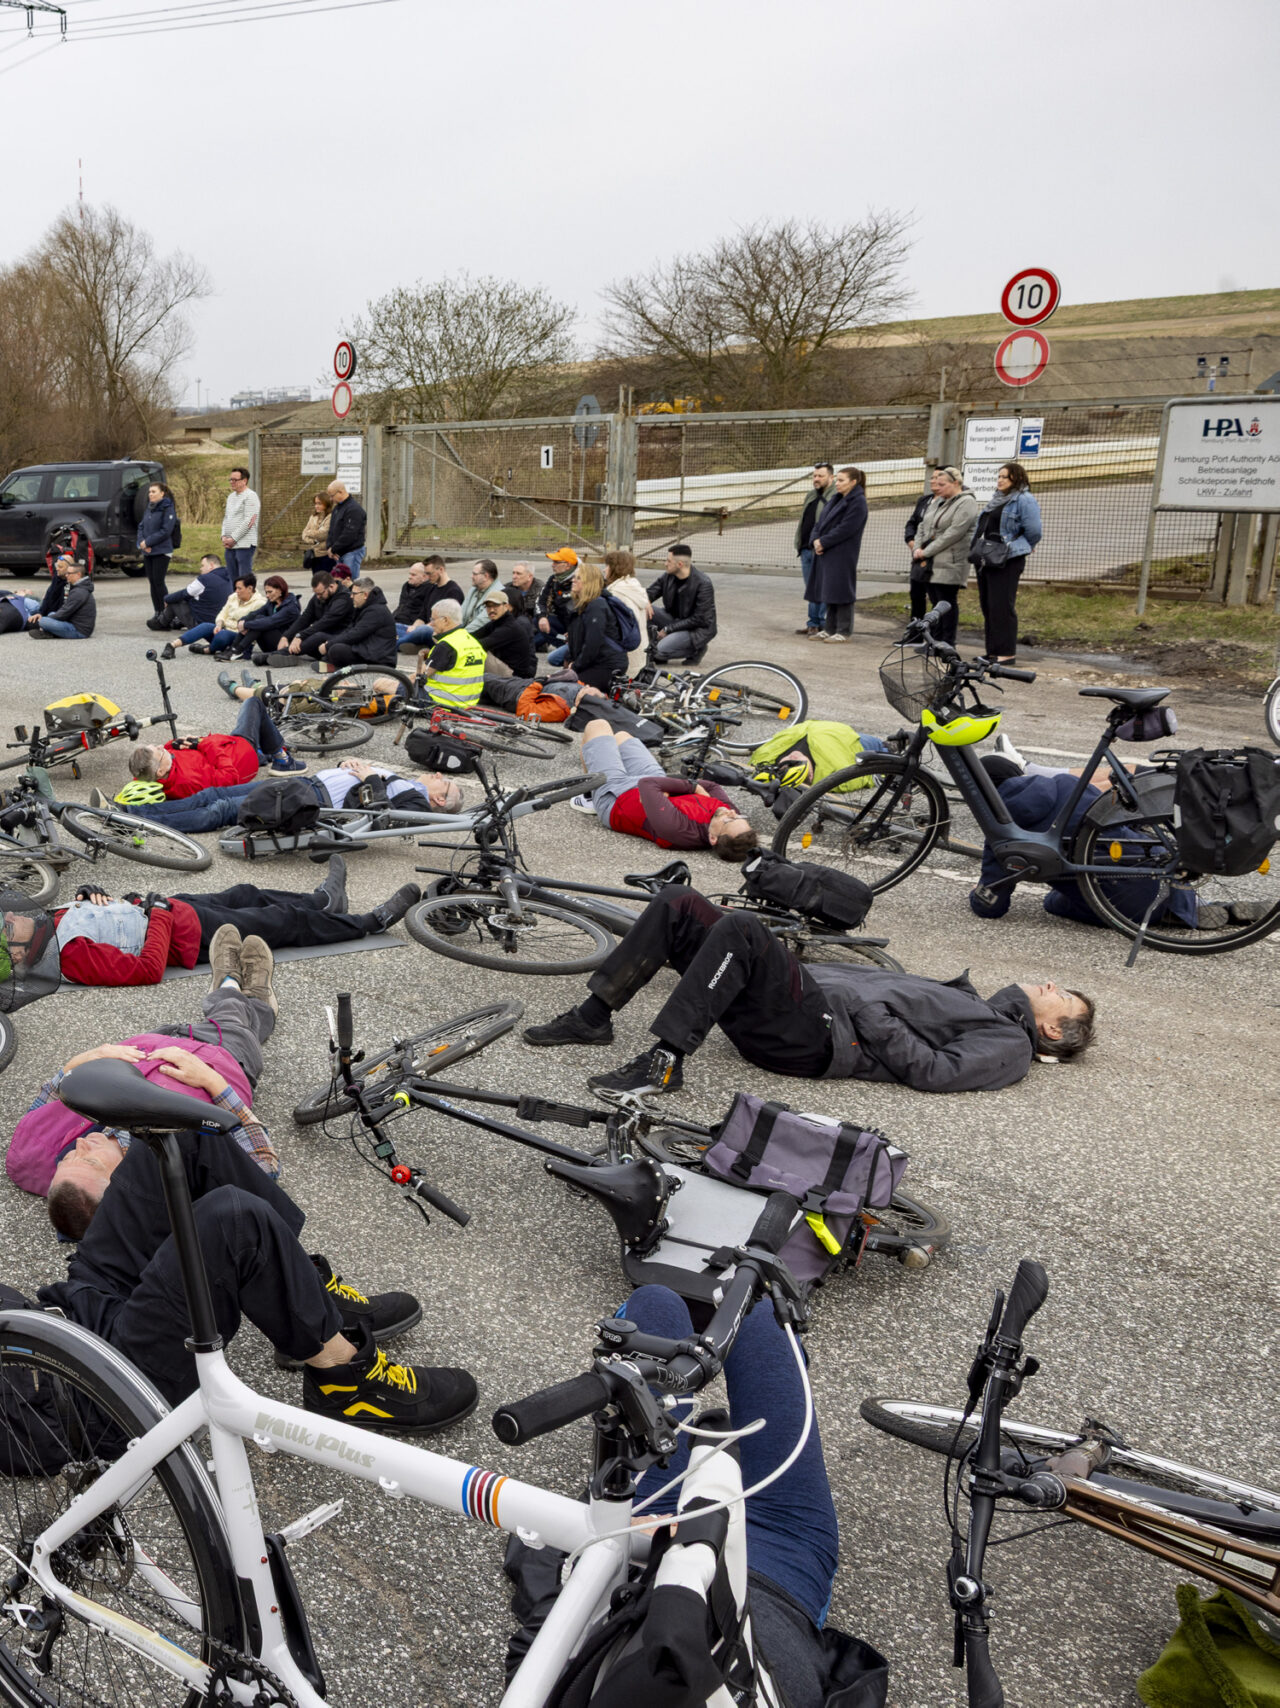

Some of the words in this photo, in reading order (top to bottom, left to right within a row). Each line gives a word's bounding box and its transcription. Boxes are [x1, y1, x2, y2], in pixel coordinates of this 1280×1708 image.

[1016, 283, 1044, 310] 10
[338, 351, 347, 368] 10
[1202, 418, 1244, 437] HPA
[543, 448, 550, 466] 1
[1174, 455, 1210, 464] Hamburg
[1212, 455, 1229, 463] Port
[1230, 455, 1266, 464] Authority
[1268, 455, 1280, 463] Aö
[967, 466, 999, 475] Unbefug
[1198, 466, 1258, 475] Betriebsanlage
[1178, 477, 1238, 486] Schlickdeponie
[1239, 477, 1276, 485] Feldhofe
[1197, 488, 1217, 496] LKW
[1223, 488, 1253, 497] Zufahrt
[707, 951, 734, 990] ROCKBROS
[254, 1411, 315, 1447] Milk
[314, 1431, 376, 1469] Plus
